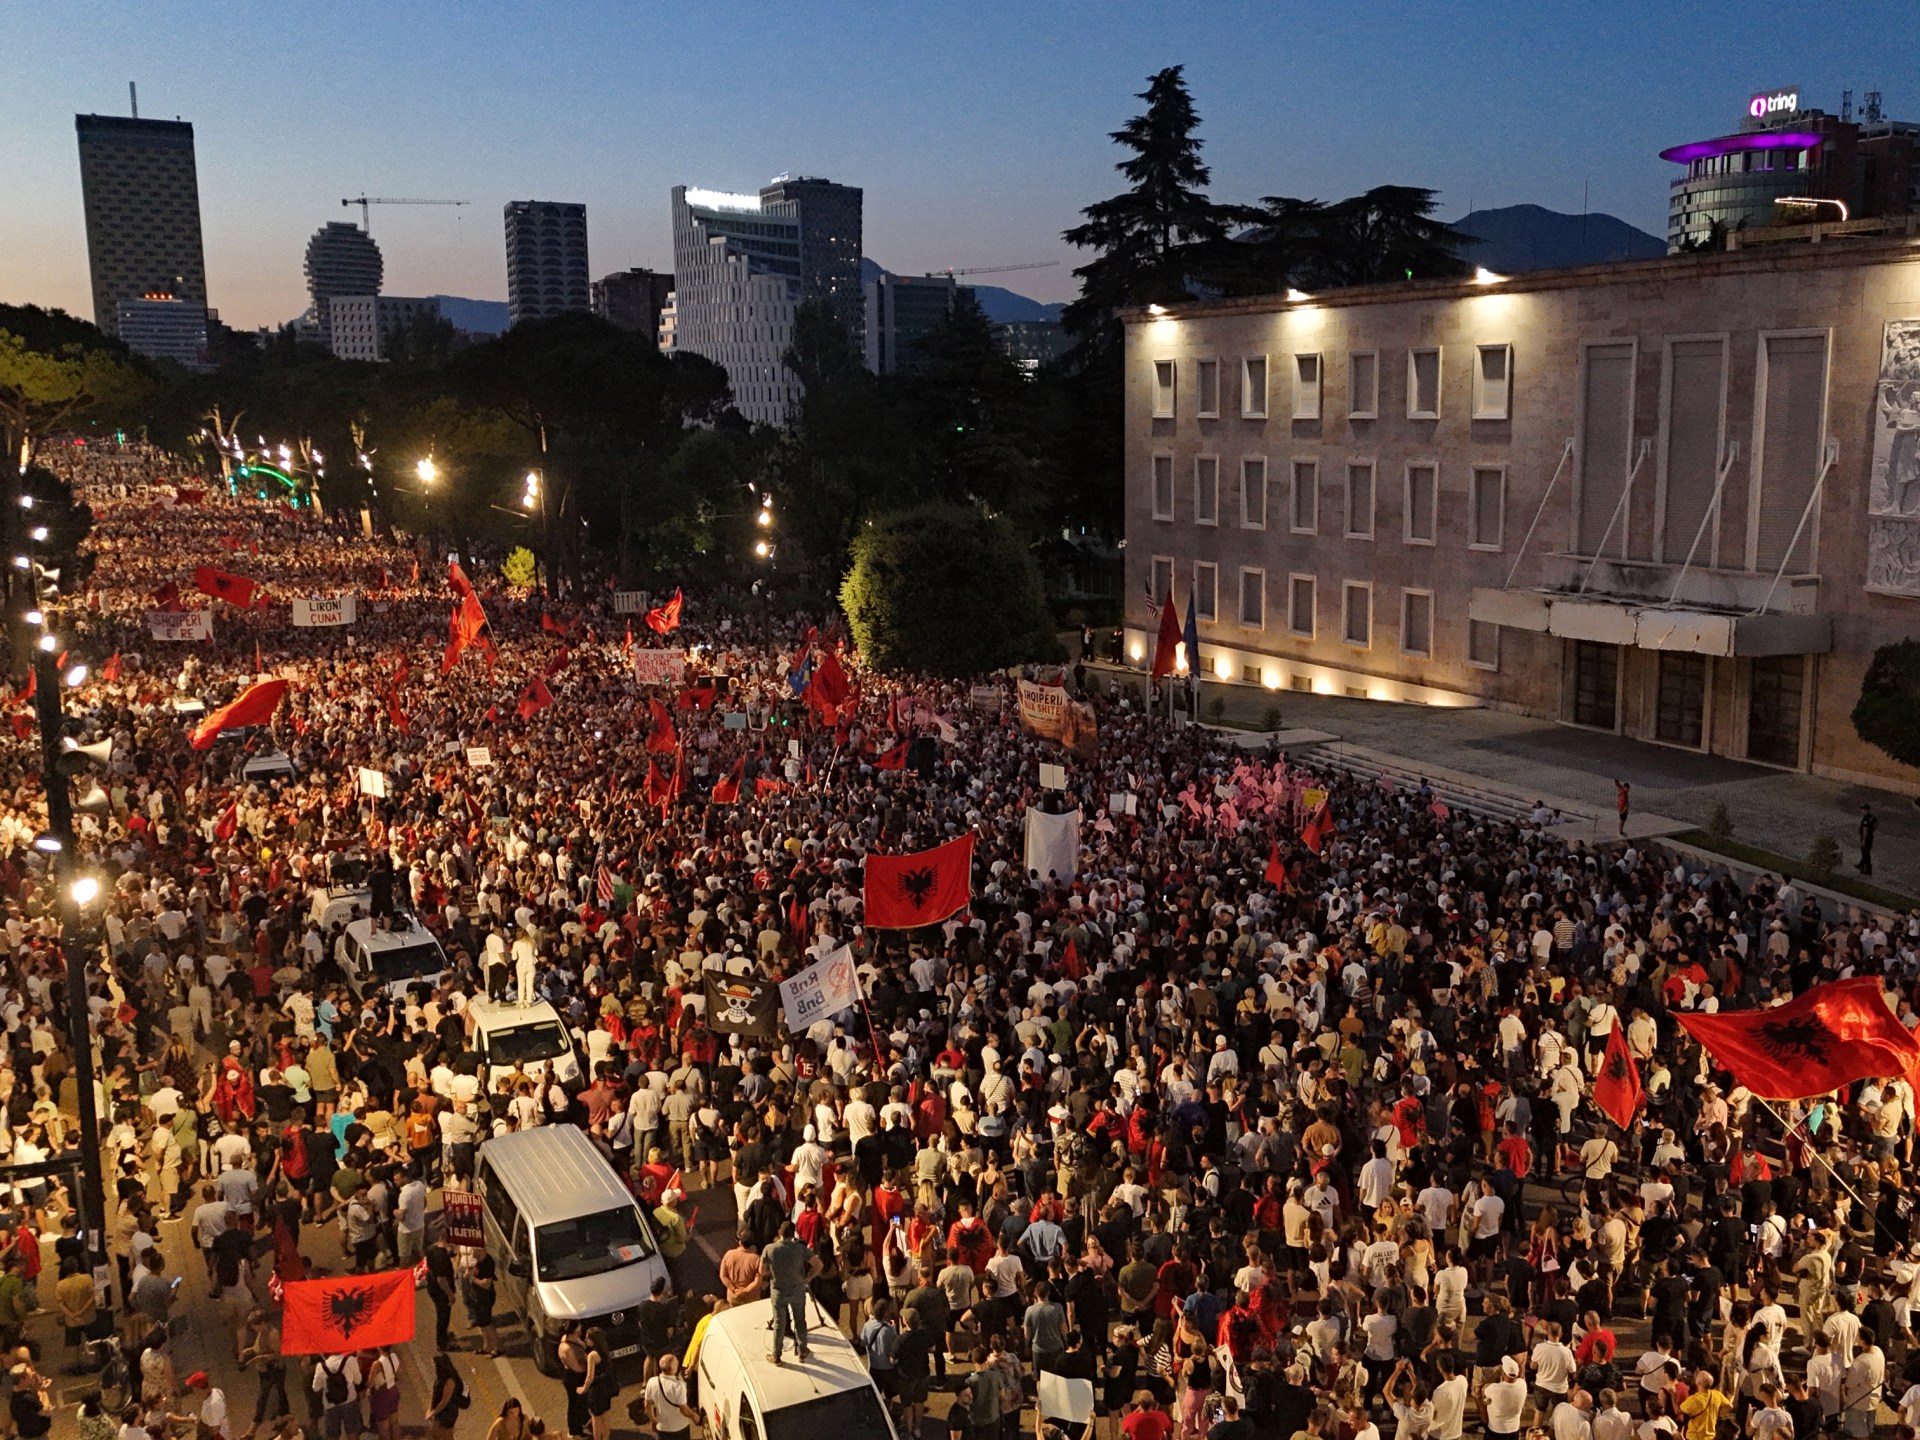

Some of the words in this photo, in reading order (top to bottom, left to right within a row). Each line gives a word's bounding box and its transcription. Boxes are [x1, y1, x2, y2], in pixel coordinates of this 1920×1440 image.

[1767, 93, 1797, 112] tring
[309, 600, 342, 611] LIRONI
[310, 612, 342, 625] ÇUNAT
[166, 629, 173, 638] E
[180, 629, 194, 638] RE
[802, 1062, 814, 1076] 15
[445, 1193, 482, 1206] ИДИОТЫ
